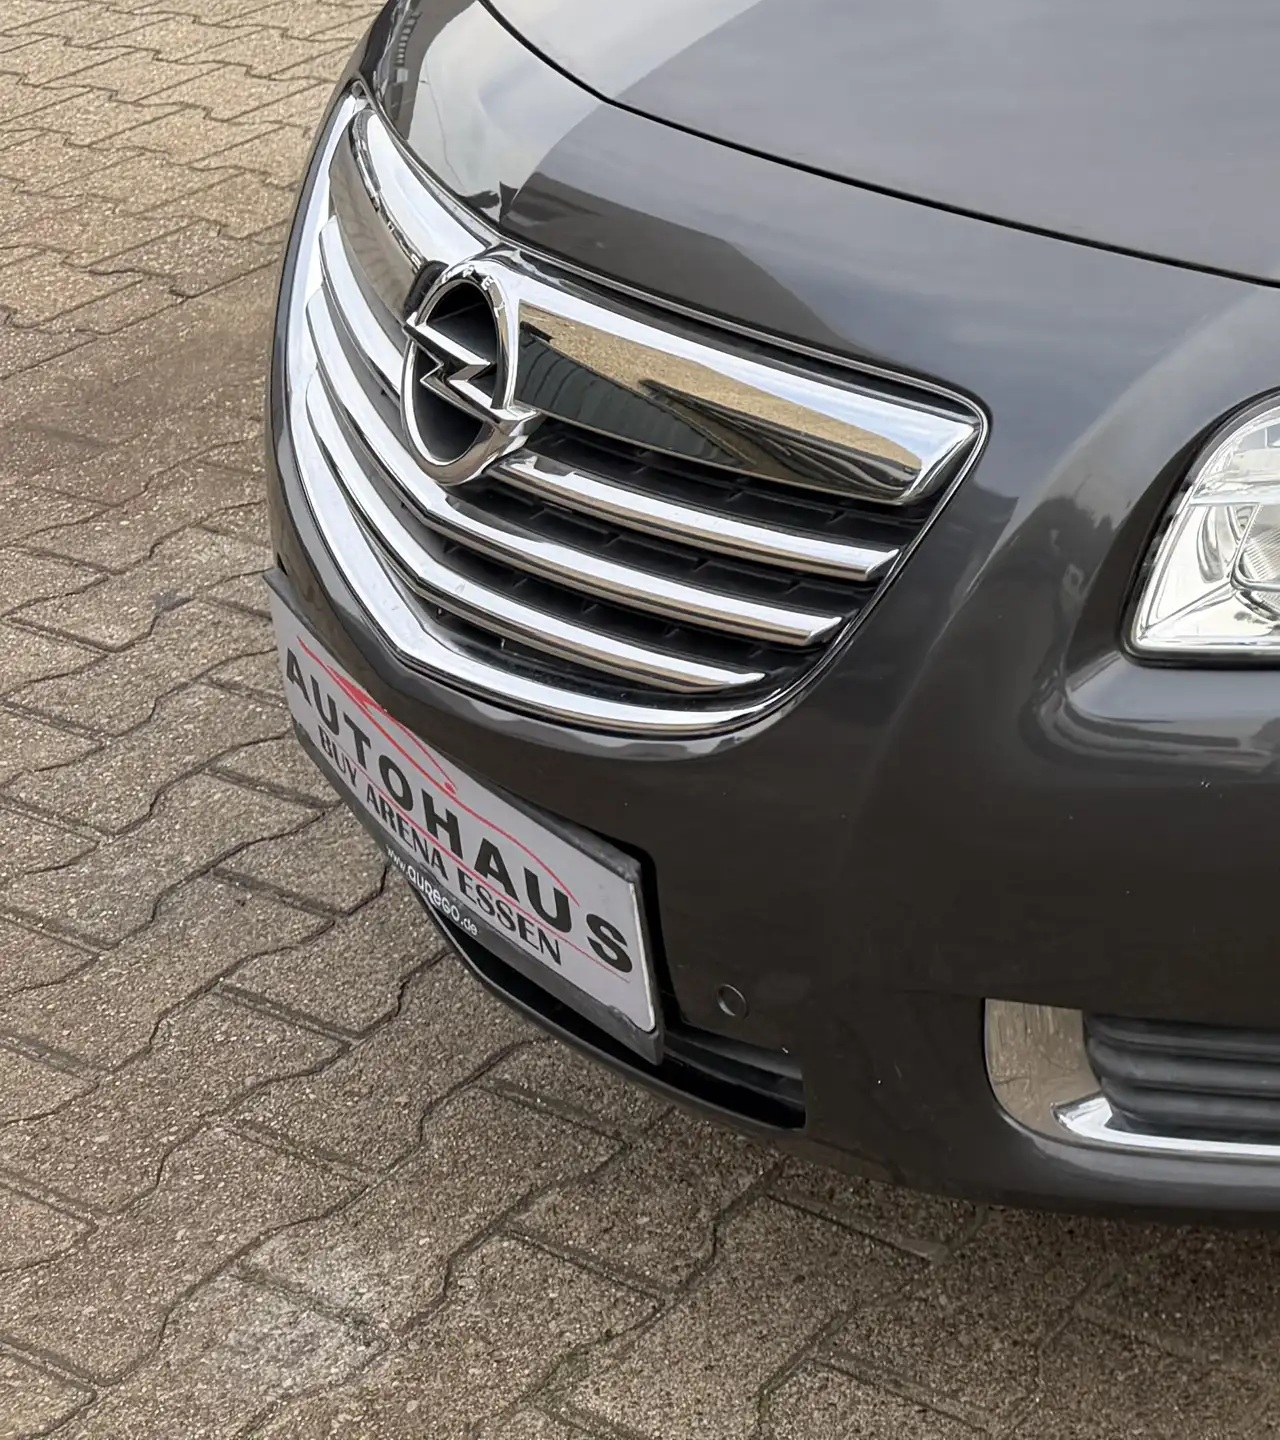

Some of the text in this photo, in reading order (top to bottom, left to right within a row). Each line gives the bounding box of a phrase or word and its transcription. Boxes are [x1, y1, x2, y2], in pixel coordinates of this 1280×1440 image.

[287, 647, 633, 973] AUTOHAUS
[317, 724, 562, 966] BUY ARENA ESSEN
